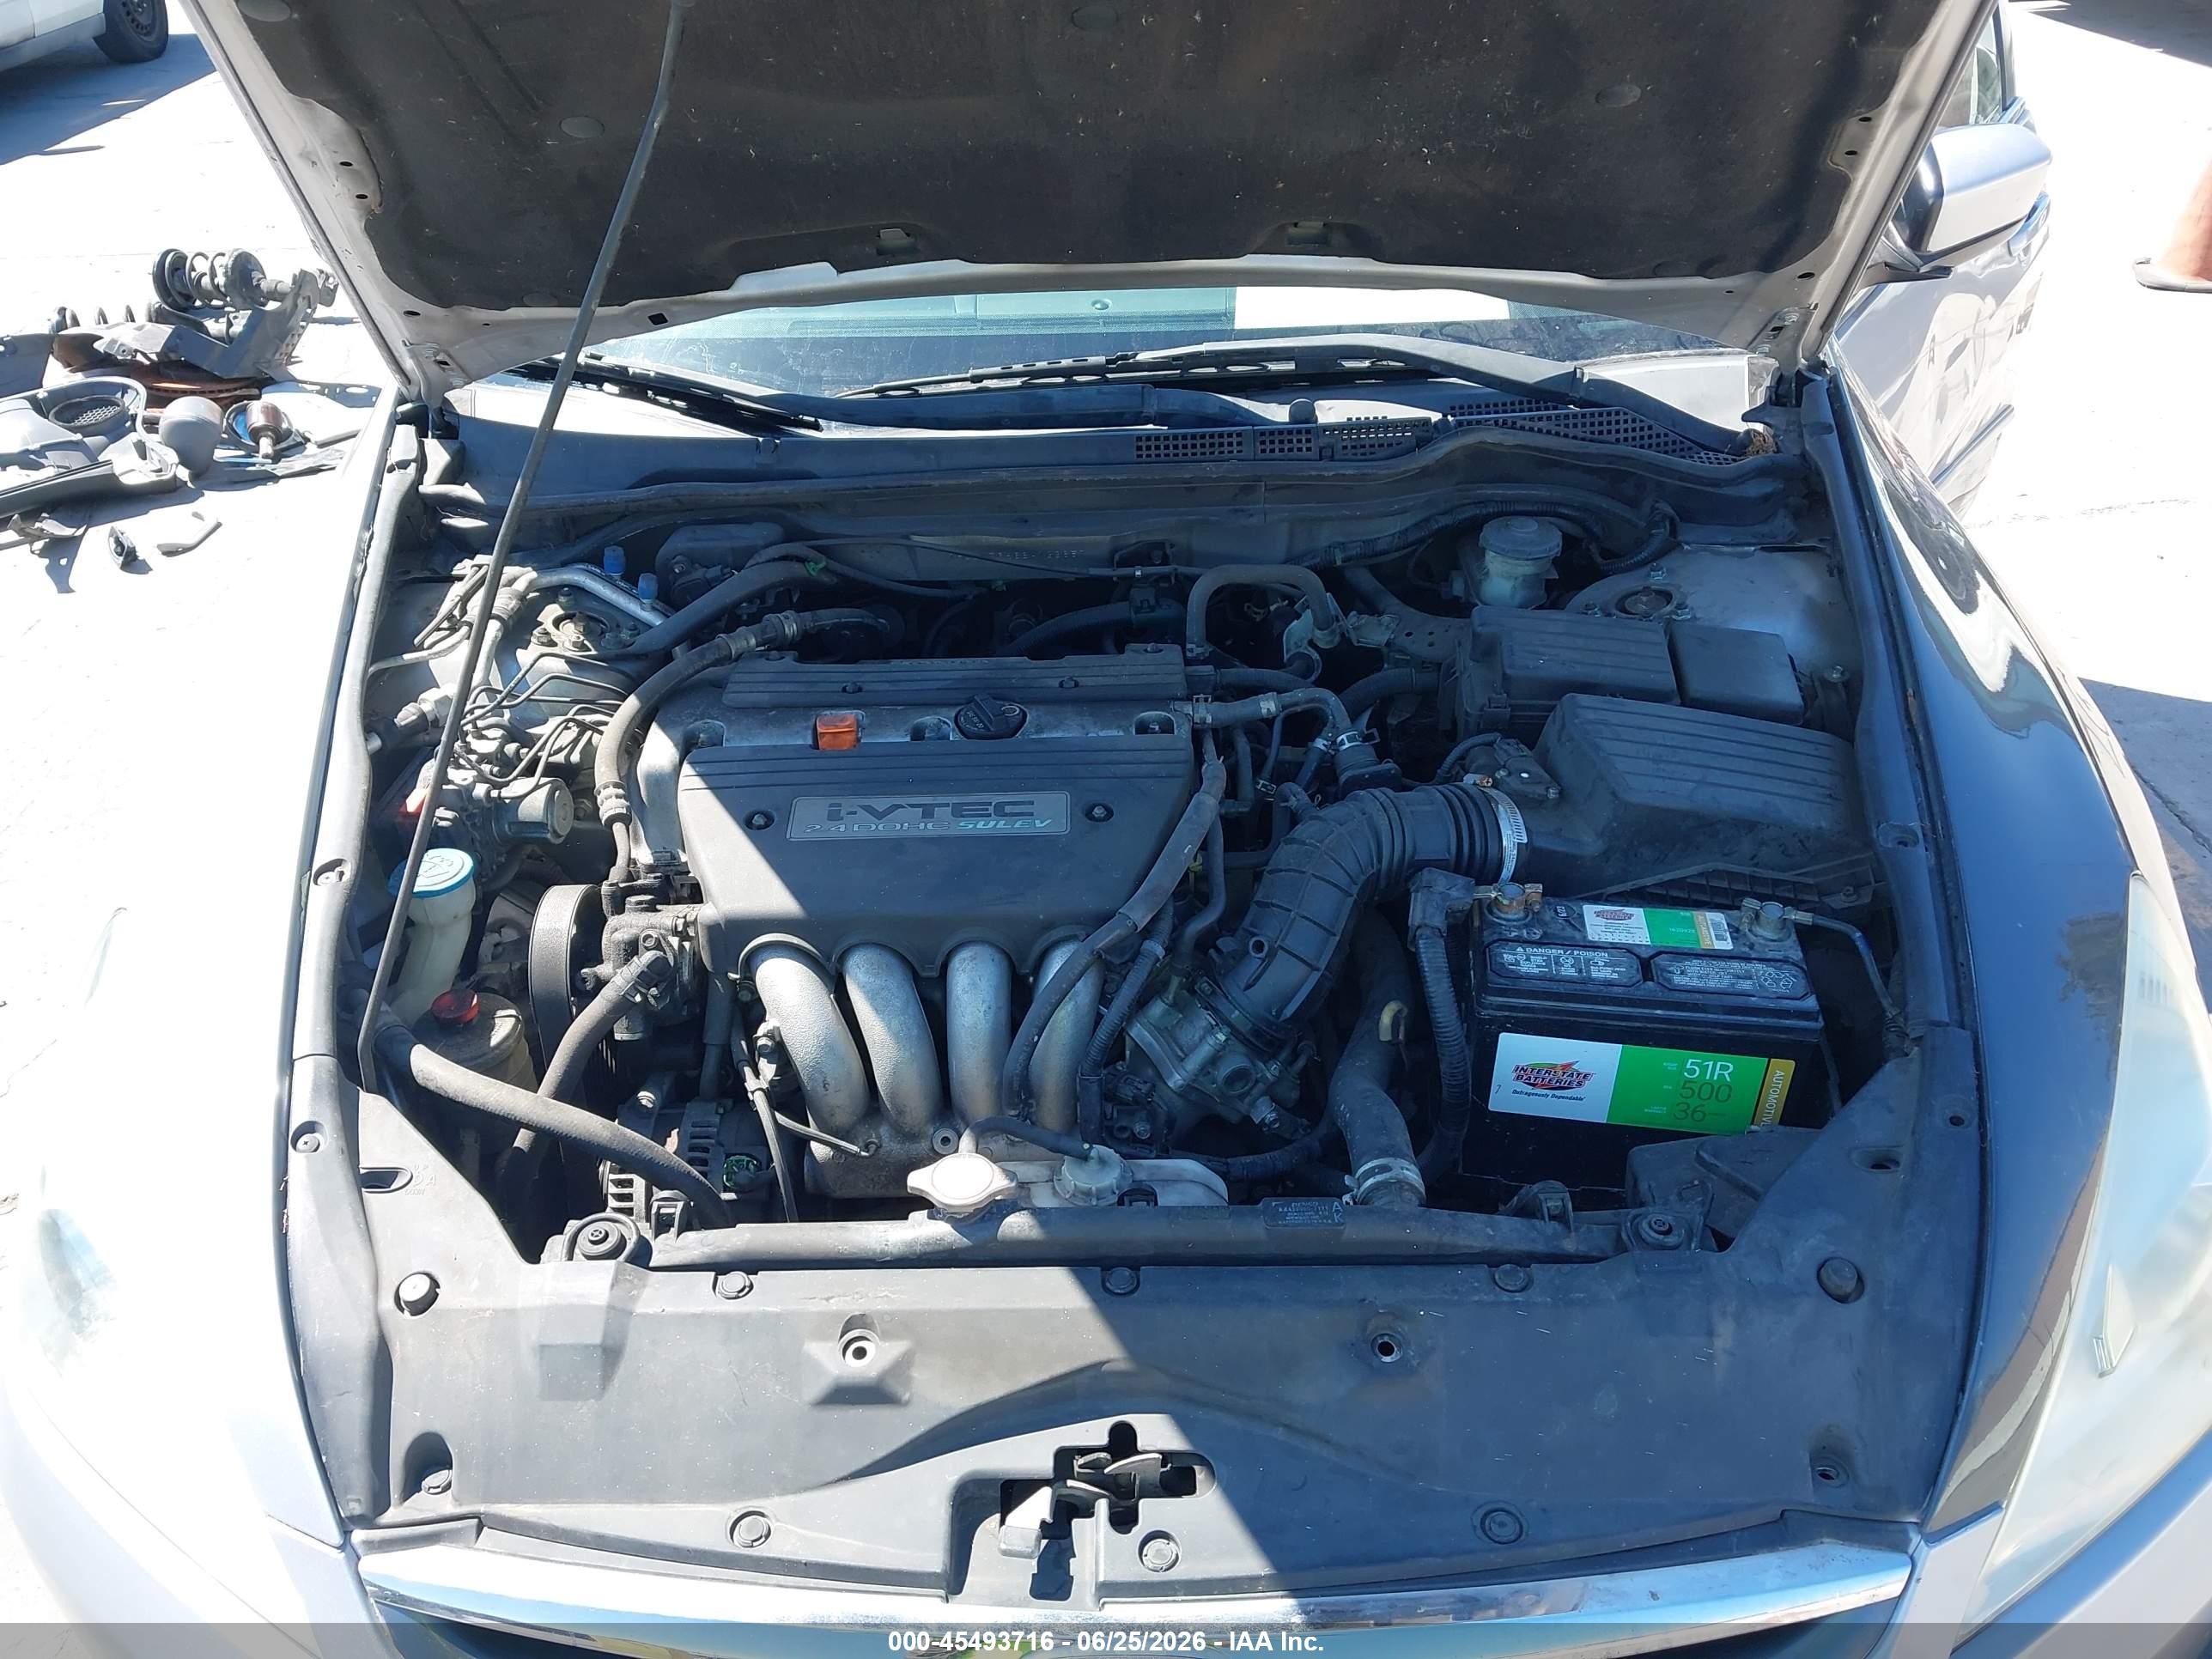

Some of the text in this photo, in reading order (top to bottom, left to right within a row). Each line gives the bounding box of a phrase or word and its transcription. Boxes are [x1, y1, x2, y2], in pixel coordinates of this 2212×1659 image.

[825, 799, 1036, 822] i-VTEC
[852, 821, 951, 832] DOHC
[958, 817, 1054, 830] SULEV
[1512, 1065, 1593, 1081] INTERSTATE
[1683, 1059, 1734, 1082] 51R
[1515, 1073, 1585, 1088] BATTERIES
[1512, 1089, 1549, 1099] Outrageously
[1679, 1080, 1732, 1103] 500
[1673, 1102, 1706, 1122] 36
